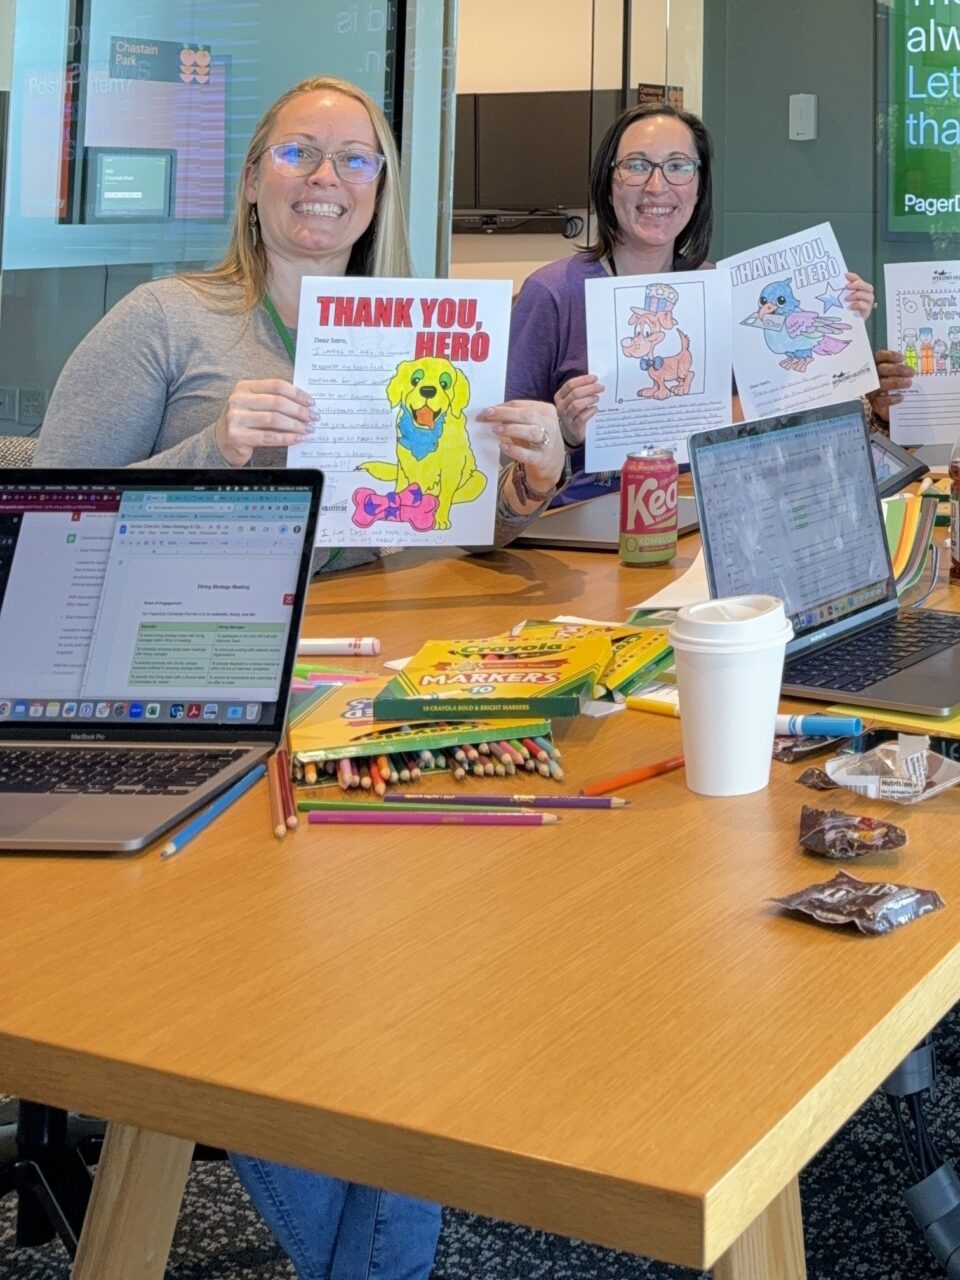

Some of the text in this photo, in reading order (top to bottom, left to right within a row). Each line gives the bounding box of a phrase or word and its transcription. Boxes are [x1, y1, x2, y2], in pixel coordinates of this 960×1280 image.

[115, 41, 158, 56] Chastain
[115, 54, 137, 66] Park
[906, 112, 960, 145] tha
[730, 237, 830, 287] THANK YOU,
[793, 256, 840, 290] HERO
[920, 294, 957, 308] Thank
[316, 295, 483, 331] THANK YOU,
[331, 337, 348, 345] hero,
[414, 330, 491, 363] HERO
[460, 643, 562, 654] Crayola
[421, 672, 558, 686] MARKERS
[470, 685, 494, 695] 10
[422, 704, 430, 712] 10
[430, 704, 457, 712] CRAYOLA
[502, 703, 530, 711] MARKERS
[71, 733, 106, 741] MacBook Pro
